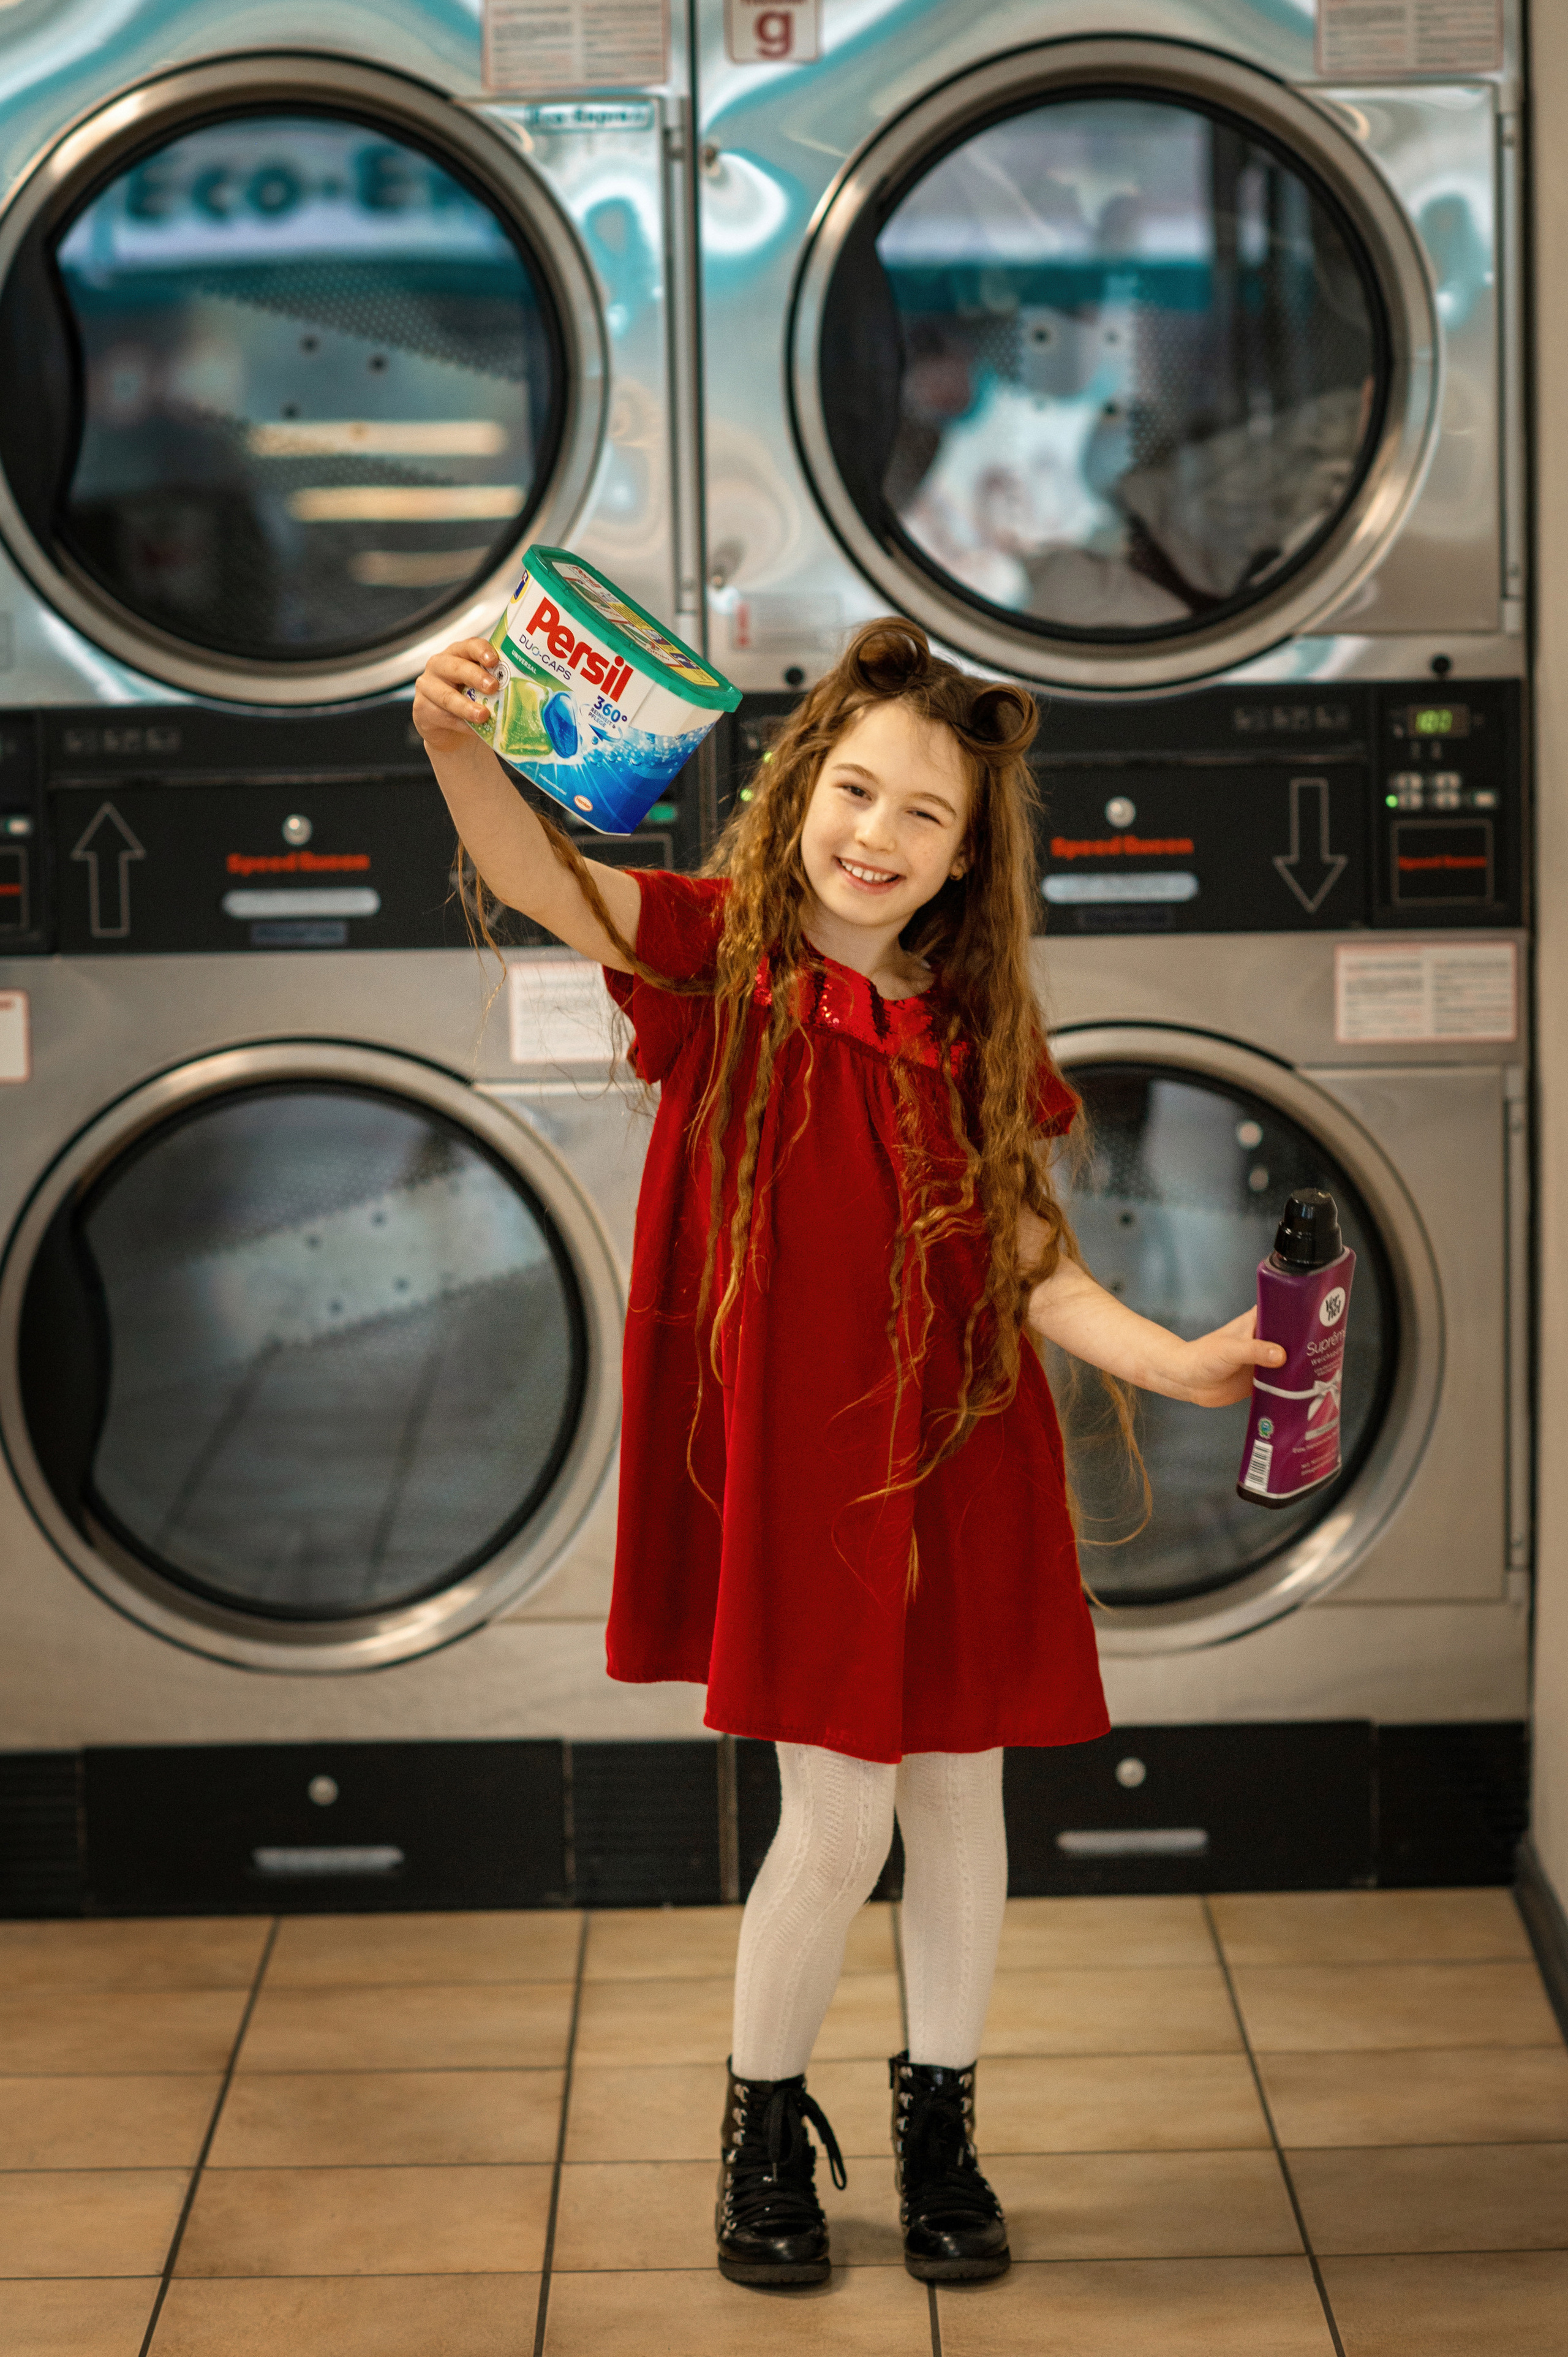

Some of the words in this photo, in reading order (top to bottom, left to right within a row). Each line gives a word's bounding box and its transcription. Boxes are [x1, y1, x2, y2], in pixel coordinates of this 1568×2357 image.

[511, 649, 537, 674] UNIVERSAL
[519, 634, 571, 680] DUO-CAPS
[526, 597, 634, 703] Persil
[588, 712, 606, 728] PFLEGE
[590, 707, 612, 725] REINHEIT
[594, 695, 628, 722] 360°
